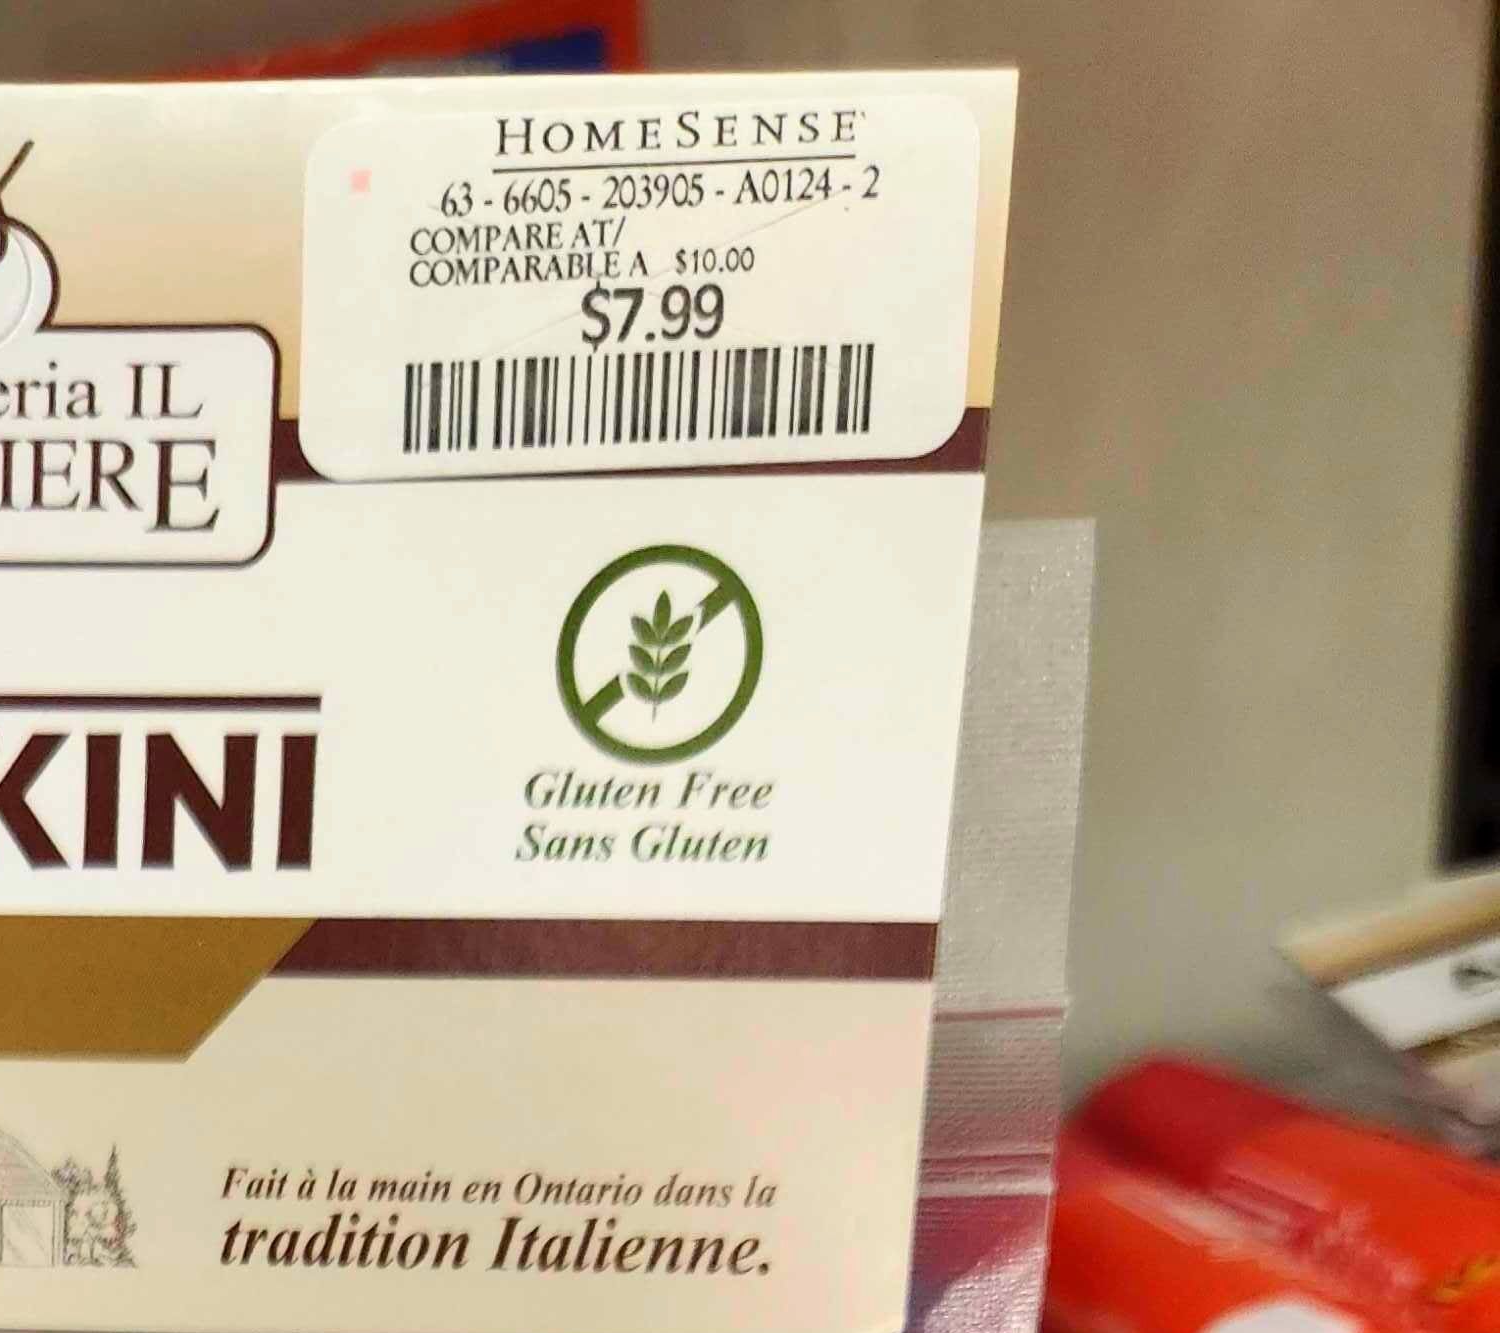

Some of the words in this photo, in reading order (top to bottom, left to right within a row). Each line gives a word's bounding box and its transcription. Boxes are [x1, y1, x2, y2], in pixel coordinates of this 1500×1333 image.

[409, 224, 564, 256] COMPARE
[570, 215, 628, 250] AT/
[409, 250, 622, 287] COMPARABLE
[630, 250, 650, 278] A
[674, 244, 757, 277] $10.00
[579, 278, 726, 356] $7.99
[127, 361, 204, 420] IL
[523, 769, 662, 809] Gluten
[677, 769, 774, 810] Free
[514, 822, 616, 862] Sans
[629, 822, 770, 862] Gluten
[221, 1165, 290, 1200] Fait
[296, 1167, 318, 1201] à
[326, 1167, 359, 1202] la
[366, 1169, 453, 1203] main
[461, 1179, 503, 1204] en
[512, 1171, 644, 1207] Ontario
[652, 1172, 735, 1208] dans
[745, 1174, 779, 1209] la
[219, 1210, 471, 1271] tradition
[488, 1214, 771, 1276] Italienne.
